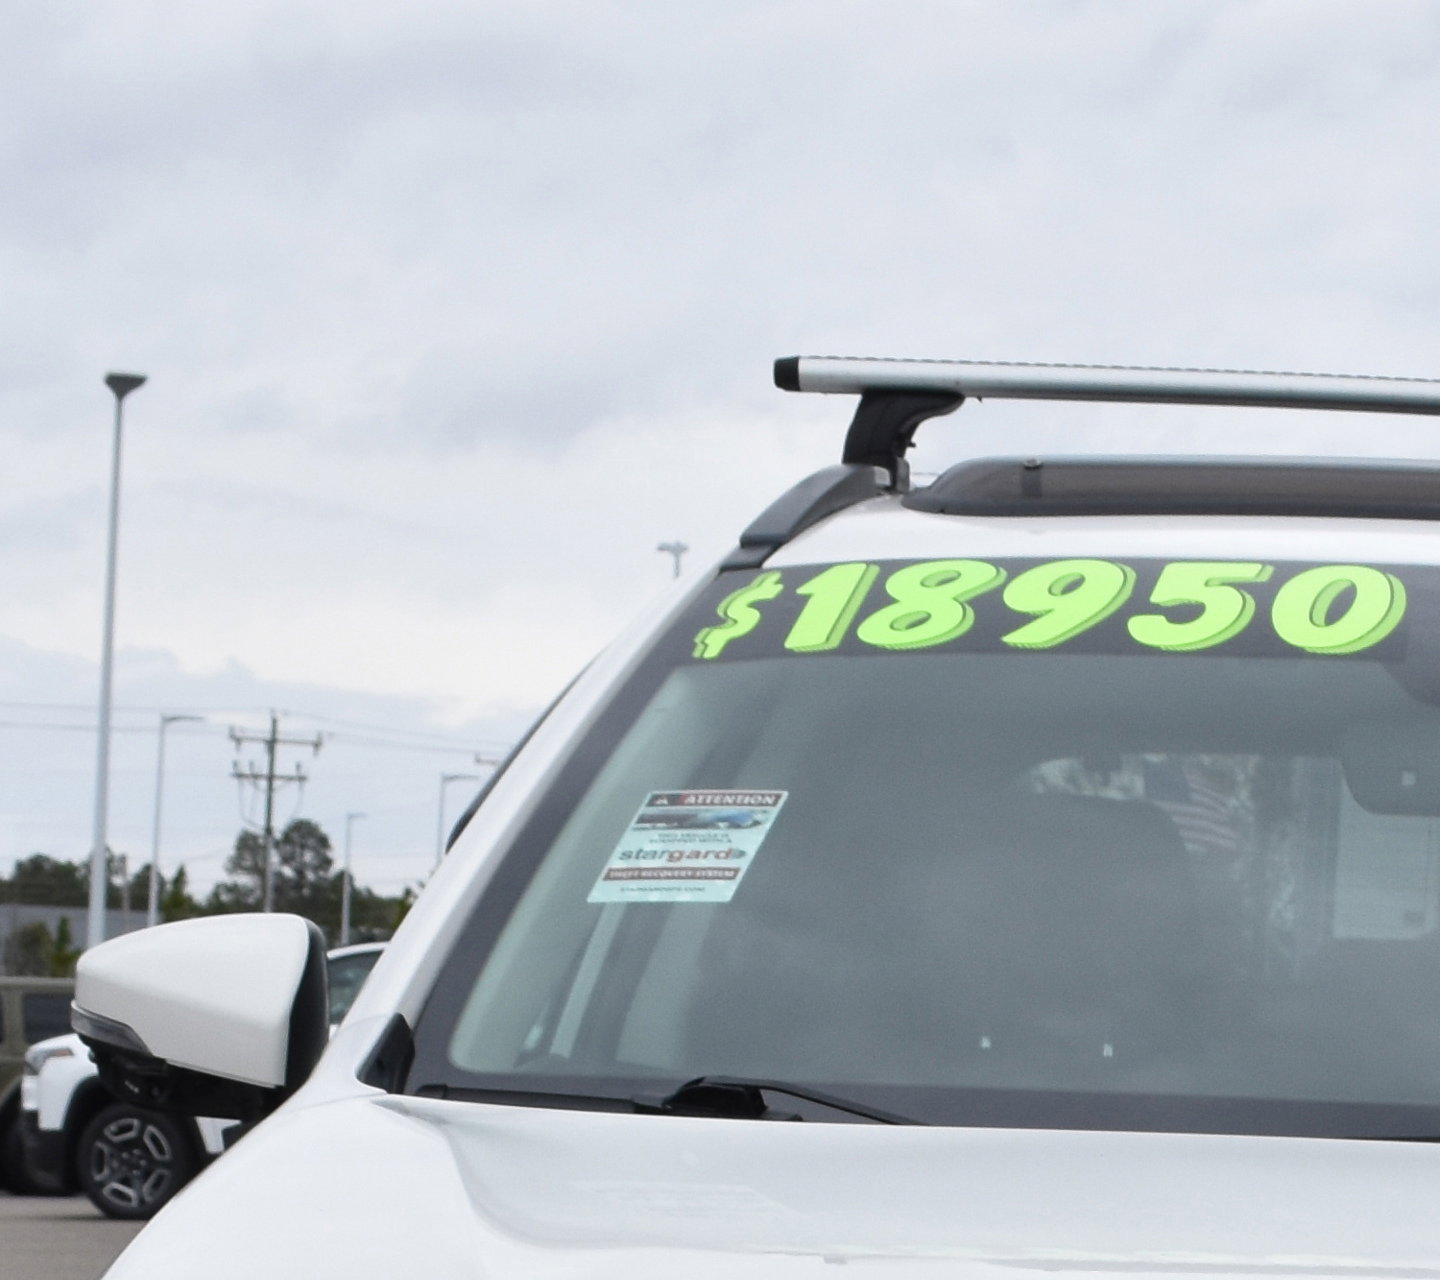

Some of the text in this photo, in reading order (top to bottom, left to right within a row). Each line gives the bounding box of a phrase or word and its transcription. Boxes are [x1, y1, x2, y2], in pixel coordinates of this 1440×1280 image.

[693, 558, 1407, 658] $18950
[684, 794, 776, 805] ATTENTION
[620, 848, 734, 862] stargard
